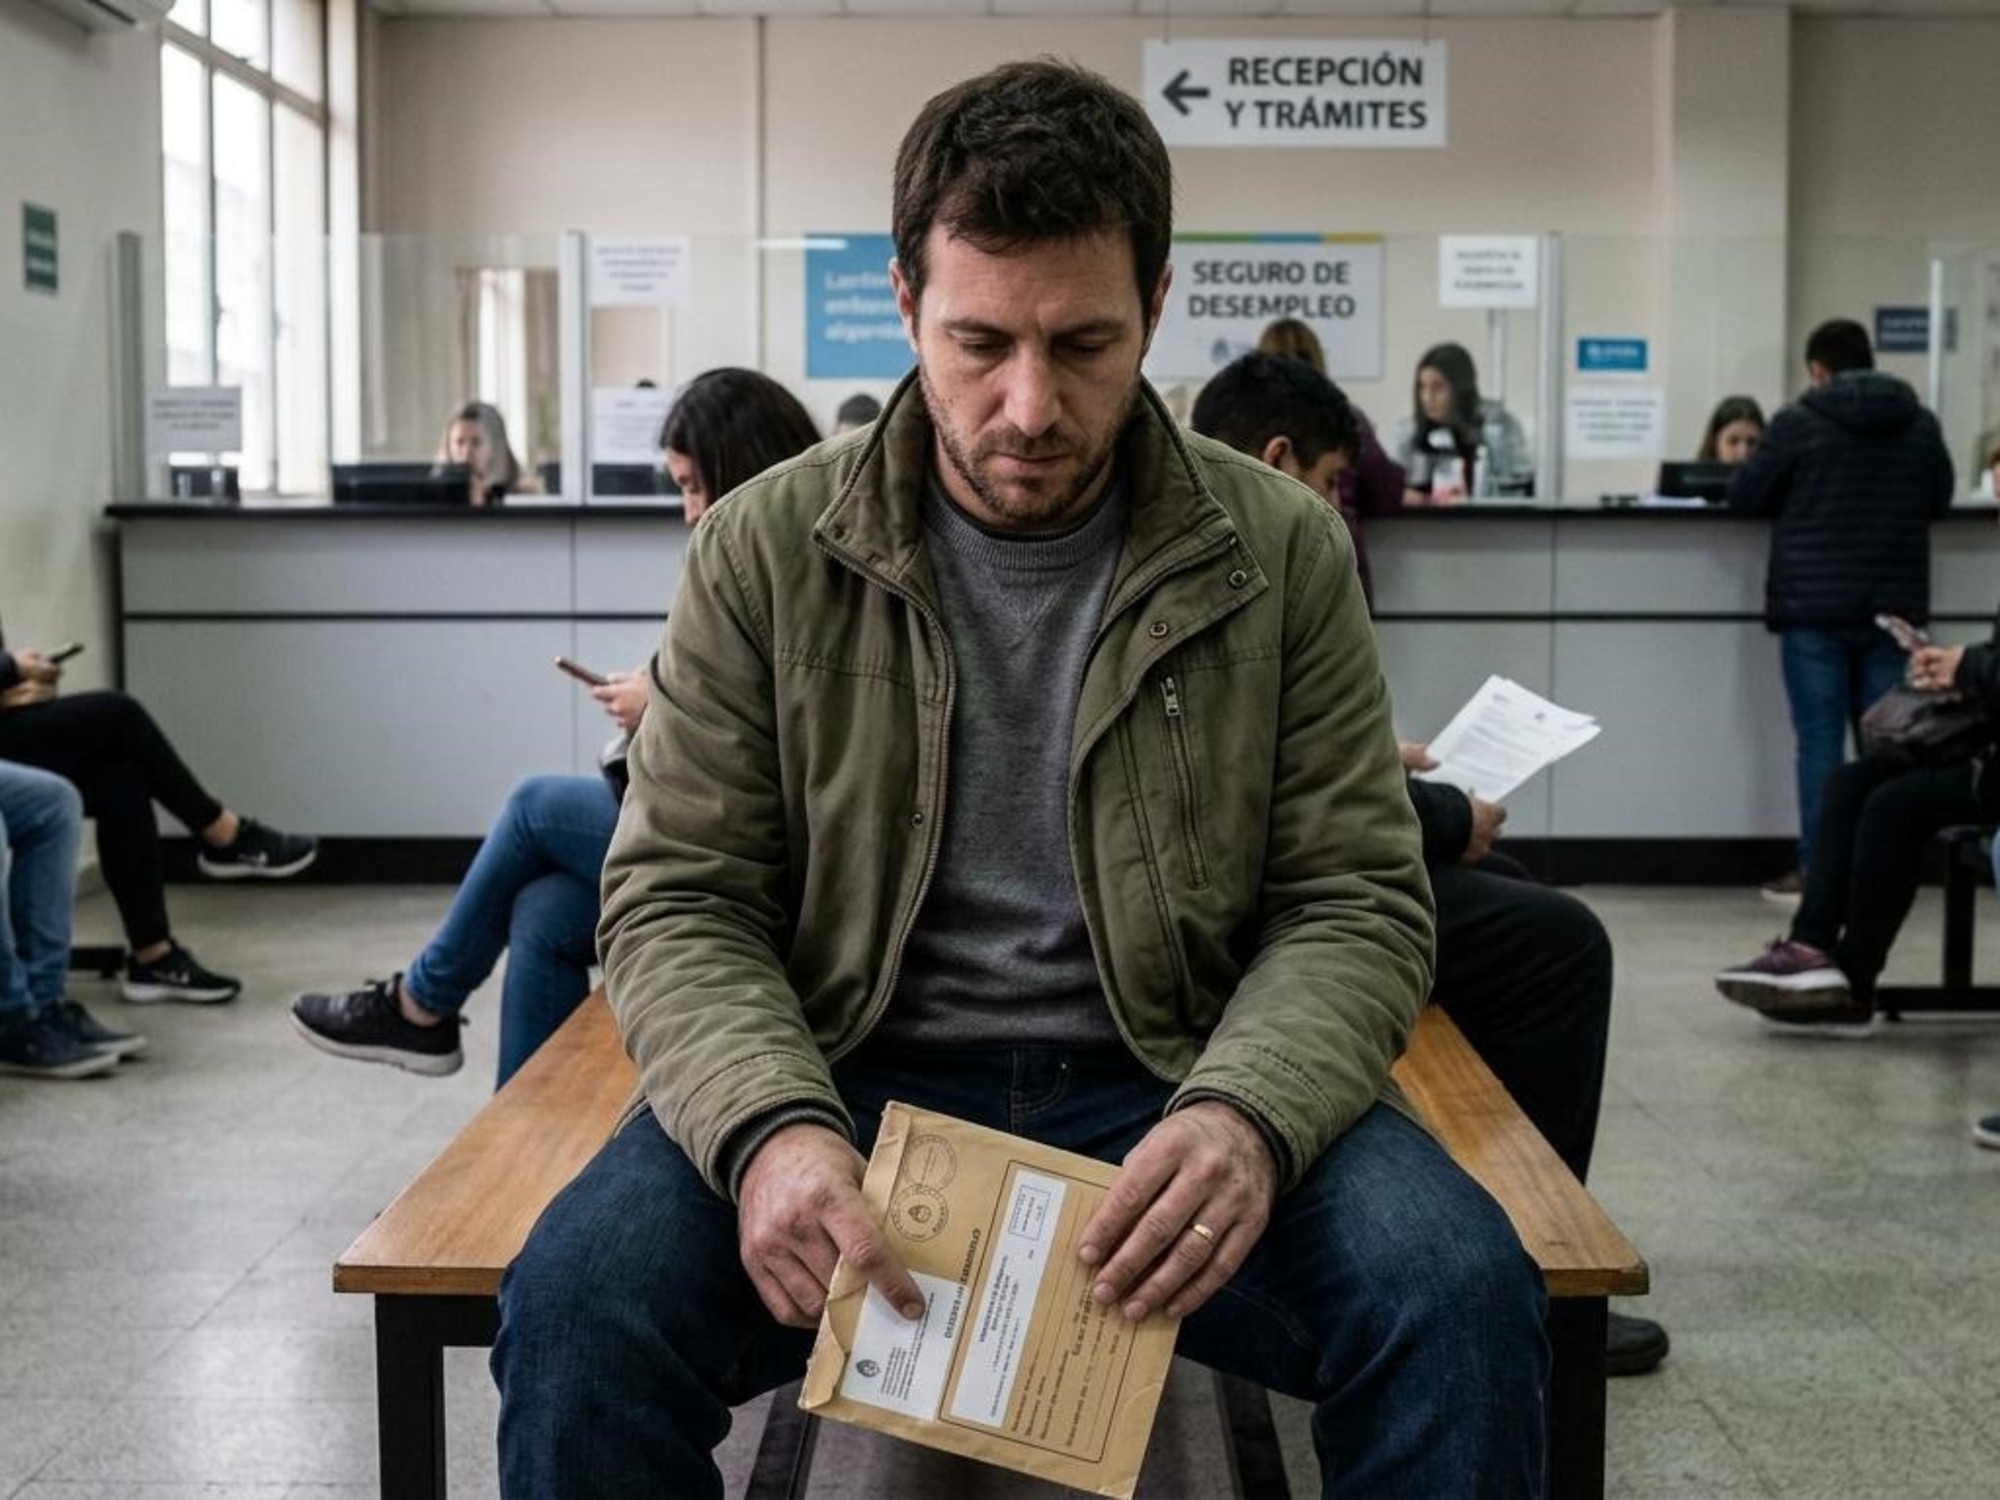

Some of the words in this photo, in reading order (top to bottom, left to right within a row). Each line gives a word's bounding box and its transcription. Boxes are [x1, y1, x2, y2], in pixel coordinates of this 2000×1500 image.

[1229, 51, 1424, 86] RECEPCIÓN
[1224, 101, 1246, 128] Y
[1254, 96, 1427, 128] TRÁMITES
[1193, 261, 1306, 285] SEGURO
[1314, 261, 1350, 285] DE
[1187, 295, 1356, 318] DESEMPLEO
